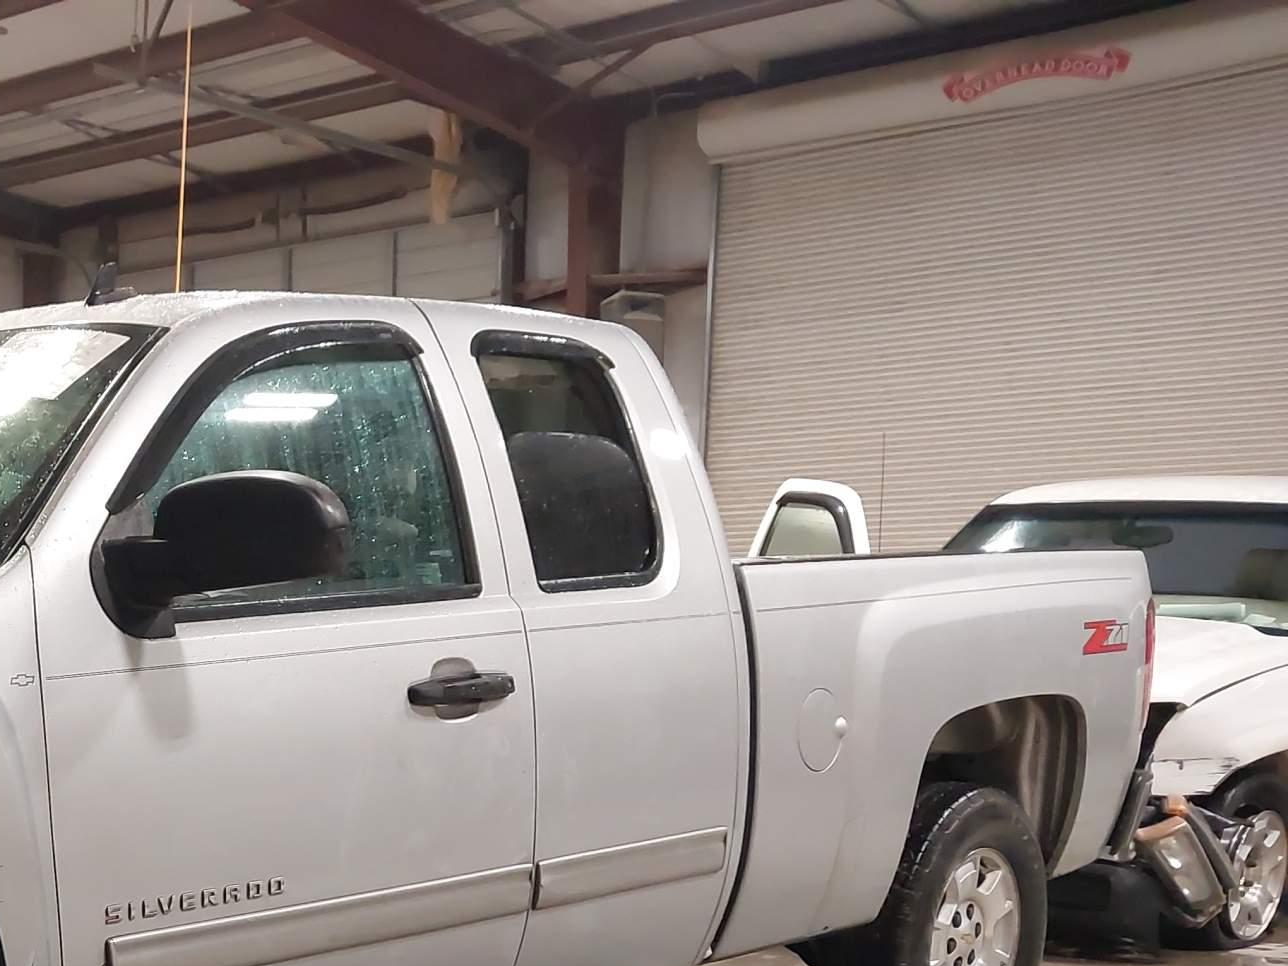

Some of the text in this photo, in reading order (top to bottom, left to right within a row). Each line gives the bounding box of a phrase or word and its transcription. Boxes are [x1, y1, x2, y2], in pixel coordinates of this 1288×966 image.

[961, 59, 1109, 99] OVERHEAD DOOR
[1082, 619, 1129, 656] Z71
[104, 876, 286, 924] SILVERADO
